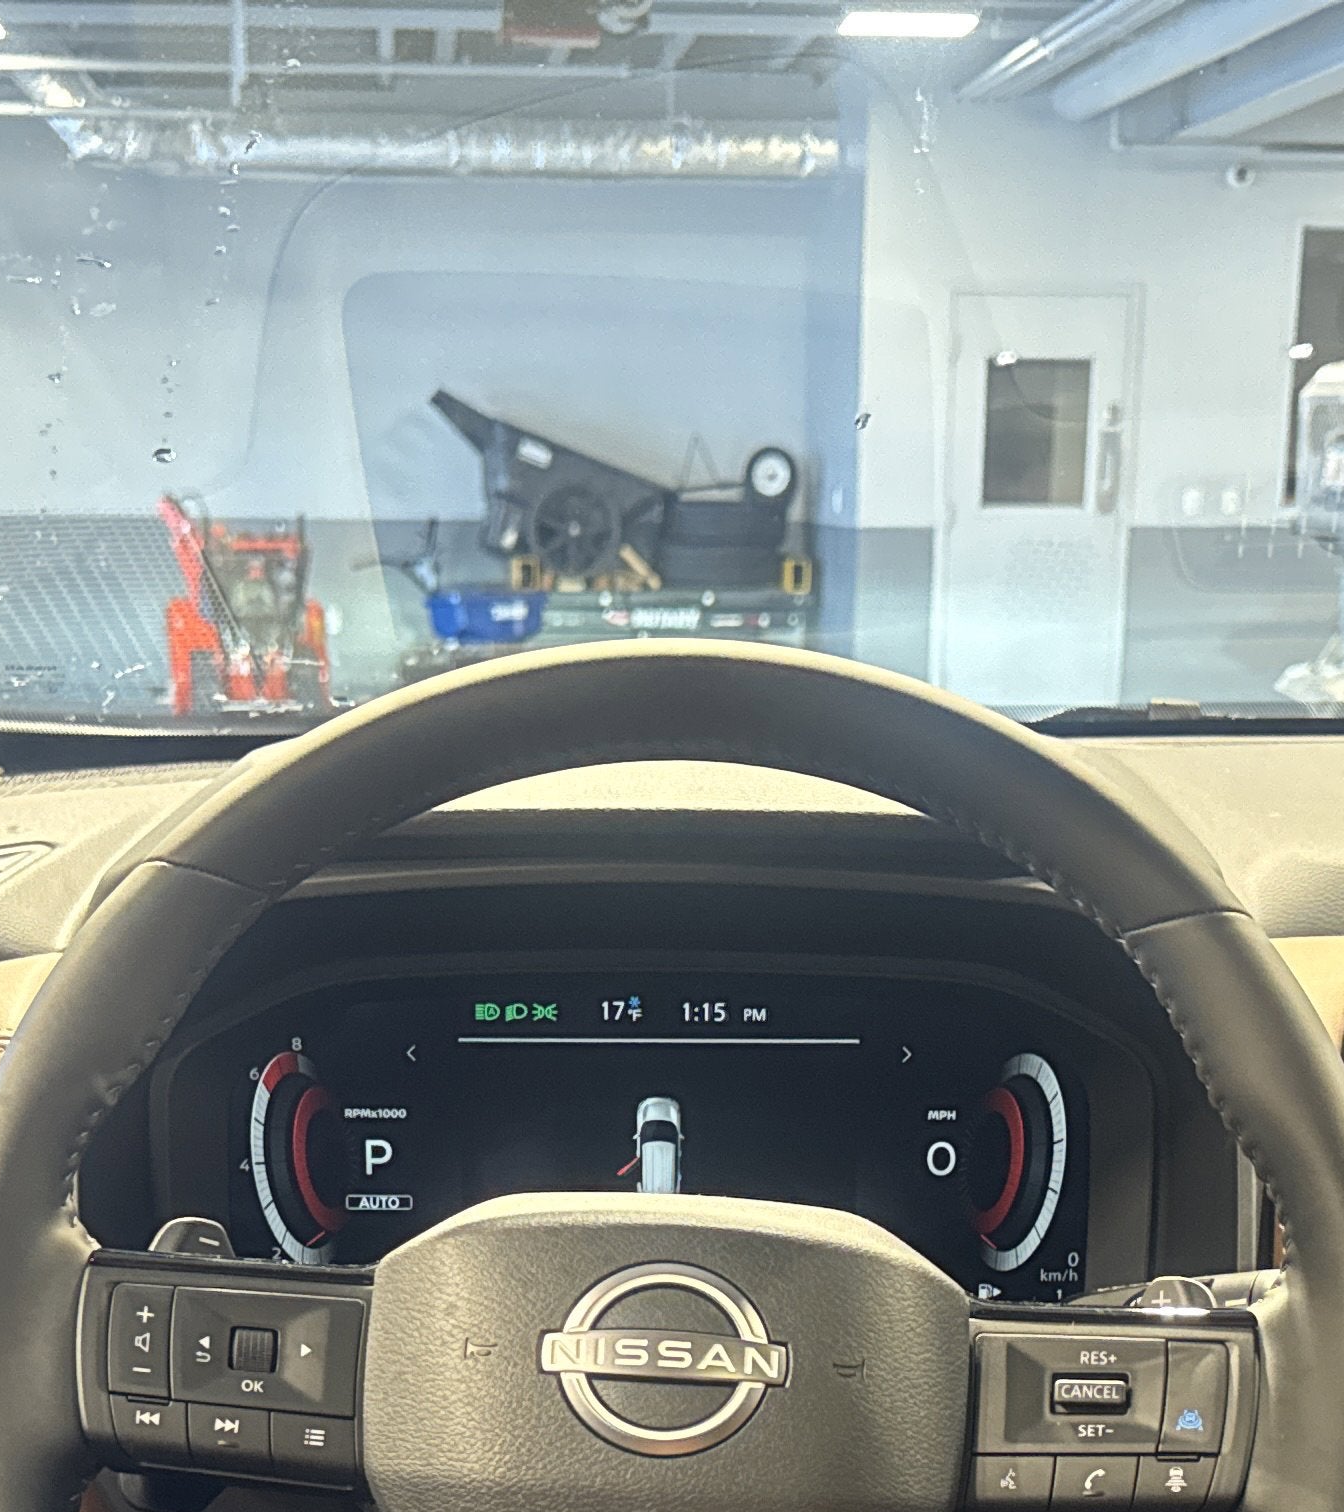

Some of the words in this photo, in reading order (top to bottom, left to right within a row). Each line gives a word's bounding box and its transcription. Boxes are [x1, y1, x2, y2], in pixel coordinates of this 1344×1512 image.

[682, 1002, 727, 1023] 1:15
[743, 1008, 767, 1022] PM
[291, 1036, 303, 1051] 8
[249, 1066, 260, 1080] 6
[927, 1109, 957, 1121] MPH
[365, 1139, 393, 1175] P
[926, 1141, 956, 1176] 0
[239, 1158, 250, 1173] 4
[358, 1195, 400, 1210] AUTO
[271, 1246, 282, 1260] 2
[1067, 1251, 1080, 1268] 0
[1040, 1268, 1079, 1282] km/h
[549, 1336, 780, 1379] NISSAN
[1079, 1350, 1118, 1365] RES+
[240, 1379, 265, 1394] OK
[1060, 1384, 1121, 1400] CANCEL
